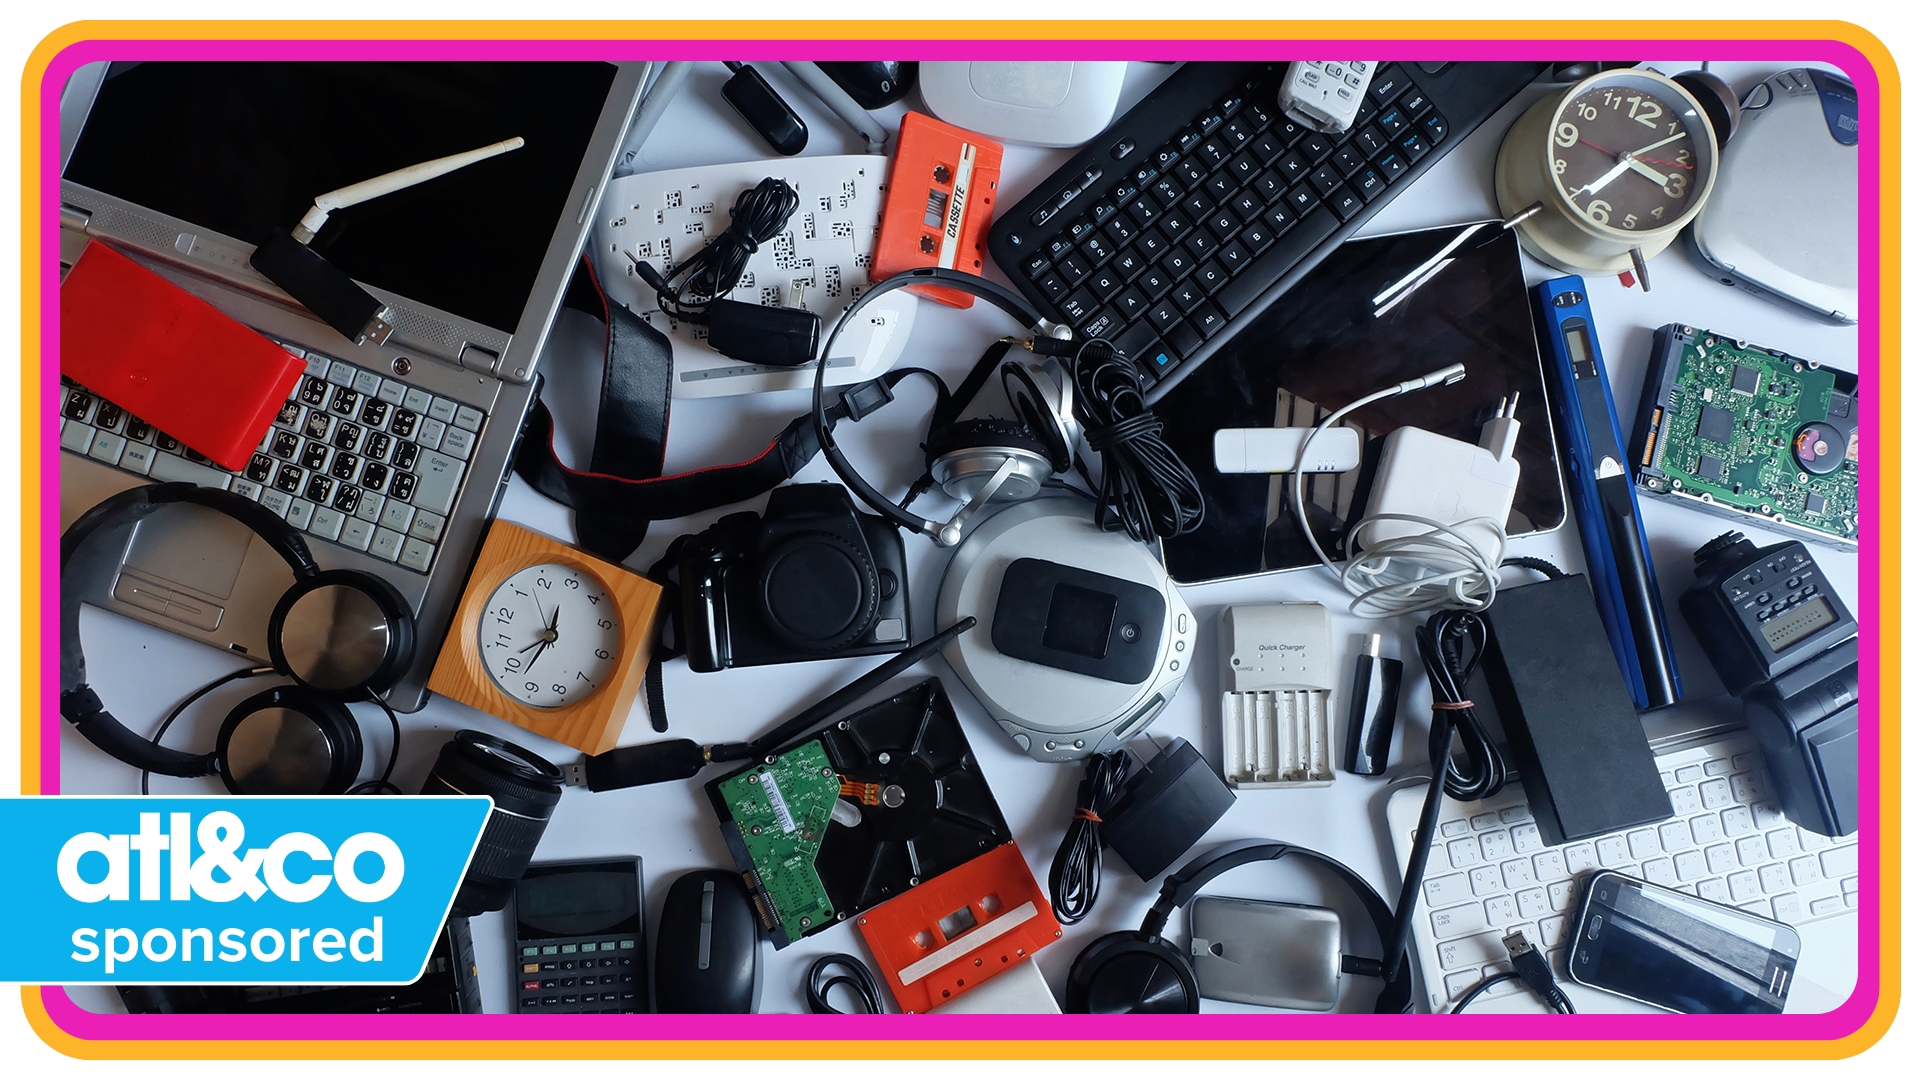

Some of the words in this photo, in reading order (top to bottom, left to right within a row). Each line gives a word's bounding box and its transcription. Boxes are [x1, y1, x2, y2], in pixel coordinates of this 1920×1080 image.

[1336, 68, 1342, 76] 0
[1360, 64, 1366, 72] 9
[1378, 80, 1394, 94] Enter
[1340, 89, 1350, 97] HOLD
[1410, 97, 1422, 109] Shift
[1604, 92, 1622, 110] 11
[1577, 102, 1598, 121] 10
[1626, 95, 1663, 129] 12
[1382, 114, 1394, 124] Page
[1428, 117, 1437, 126] End
[1668, 122, 1677, 135] 1
[1555, 122, 1579, 148] 9
[1404, 136, 1414, 147] Page
[1382, 154, 1395, 166] Home
[1675, 149, 1690, 164] 2
[1240, 162, 1248, 170] U
[1289, 161, 1297, 170] K
[1555, 159, 1567, 174] 8
[1364, 178, 1376, 188] Ctrl
[1664, 172, 1687, 199] 3
[1298, 194, 1307, 203] M
[1343, 198, 1352, 207] Alt
[1243, 200, 1251, 208] H
[947, 185, 965, 238] CASSETTE
[1586, 199, 1612, 225] 6
[1651, 206, 1664, 219] 4
[1622, 213, 1638, 230] 5
[1148, 240, 1156, 248] E
[1032, 259, 1042, 268] Esc
[1122, 258, 1133, 268] W
[1183, 292, 1191, 300] X
[1067, 301, 1077, 310] Tab
[1160, 311, 1168, 319] Z
[1205, 315, 1214, 324] Alt
[1086, 321, 1100, 332] Caps
[1090, 327, 1103, 337] Lock
[304, 391, 310, 399] 9
[384, 387, 397, 396] Home
[72, 394, 80, 403] Z
[103, 404, 110, 412] X
[334, 400, 340, 408] 0
[460, 414, 474, 422] Delete
[279, 434, 287, 442] K
[309, 445, 314, 453] L
[448, 440, 464, 448] space
[254, 456, 262, 466] M
[432, 458, 448, 467] Enter
[424, 523, 436, 531] Shift
[537, 578, 552, 590] 2
[564, 578, 579, 589] 3
[588, 594, 600, 605] 4
[497, 607, 514, 624] 12
[598, 619, 612, 630] 5
[495, 633, 512, 648] 11
[595, 649, 609, 660] 6
[504, 657, 521, 674] 10
[576, 671, 590, 682] 7
[525, 681, 539, 692] 9
[552, 683, 566, 694] 8
[1475, 873, 1482, 881] Q
